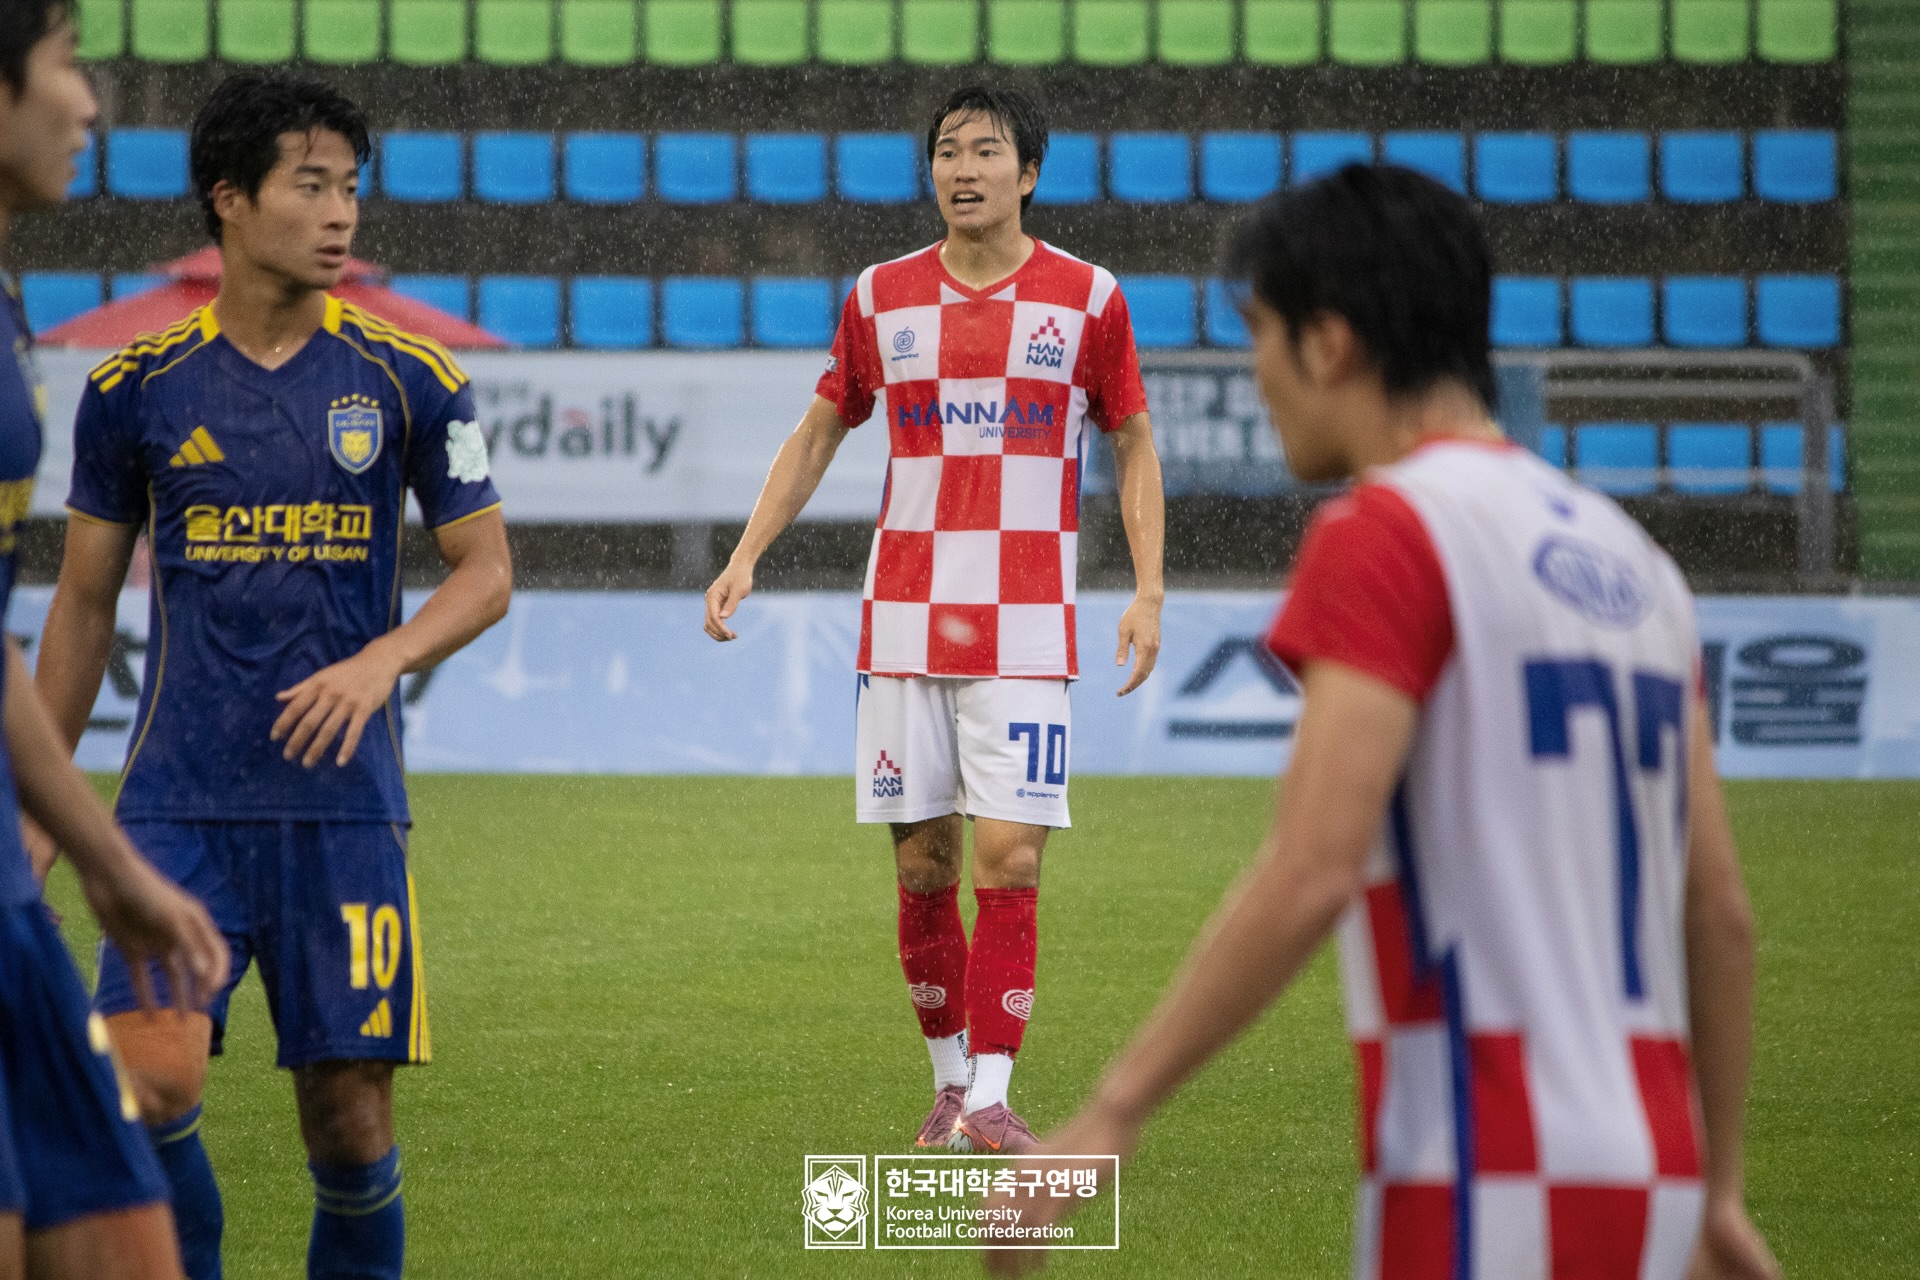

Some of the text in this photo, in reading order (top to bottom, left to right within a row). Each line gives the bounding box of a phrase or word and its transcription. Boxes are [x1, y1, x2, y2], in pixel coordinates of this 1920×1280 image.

[1027, 342, 1064, 358] HAN
[1025, 353, 1062, 369] NAM
[898, 395, 1054, 427] HANNAM
[979, 426, 1052, 440] UNIVERSITY
[184, 501, 372, 543] 울산대학교
[184, 545, 285, 563] UNIVERSITY
[287, 545, 311, 563] OF
[1008, 722, 1066, 785] 70
[873, 775, 903, 787] HAN
[872, 787, 904, 798] NAM
[1522, 657, 1690, 1005] 77
[340, 903, 402, 990] 10
